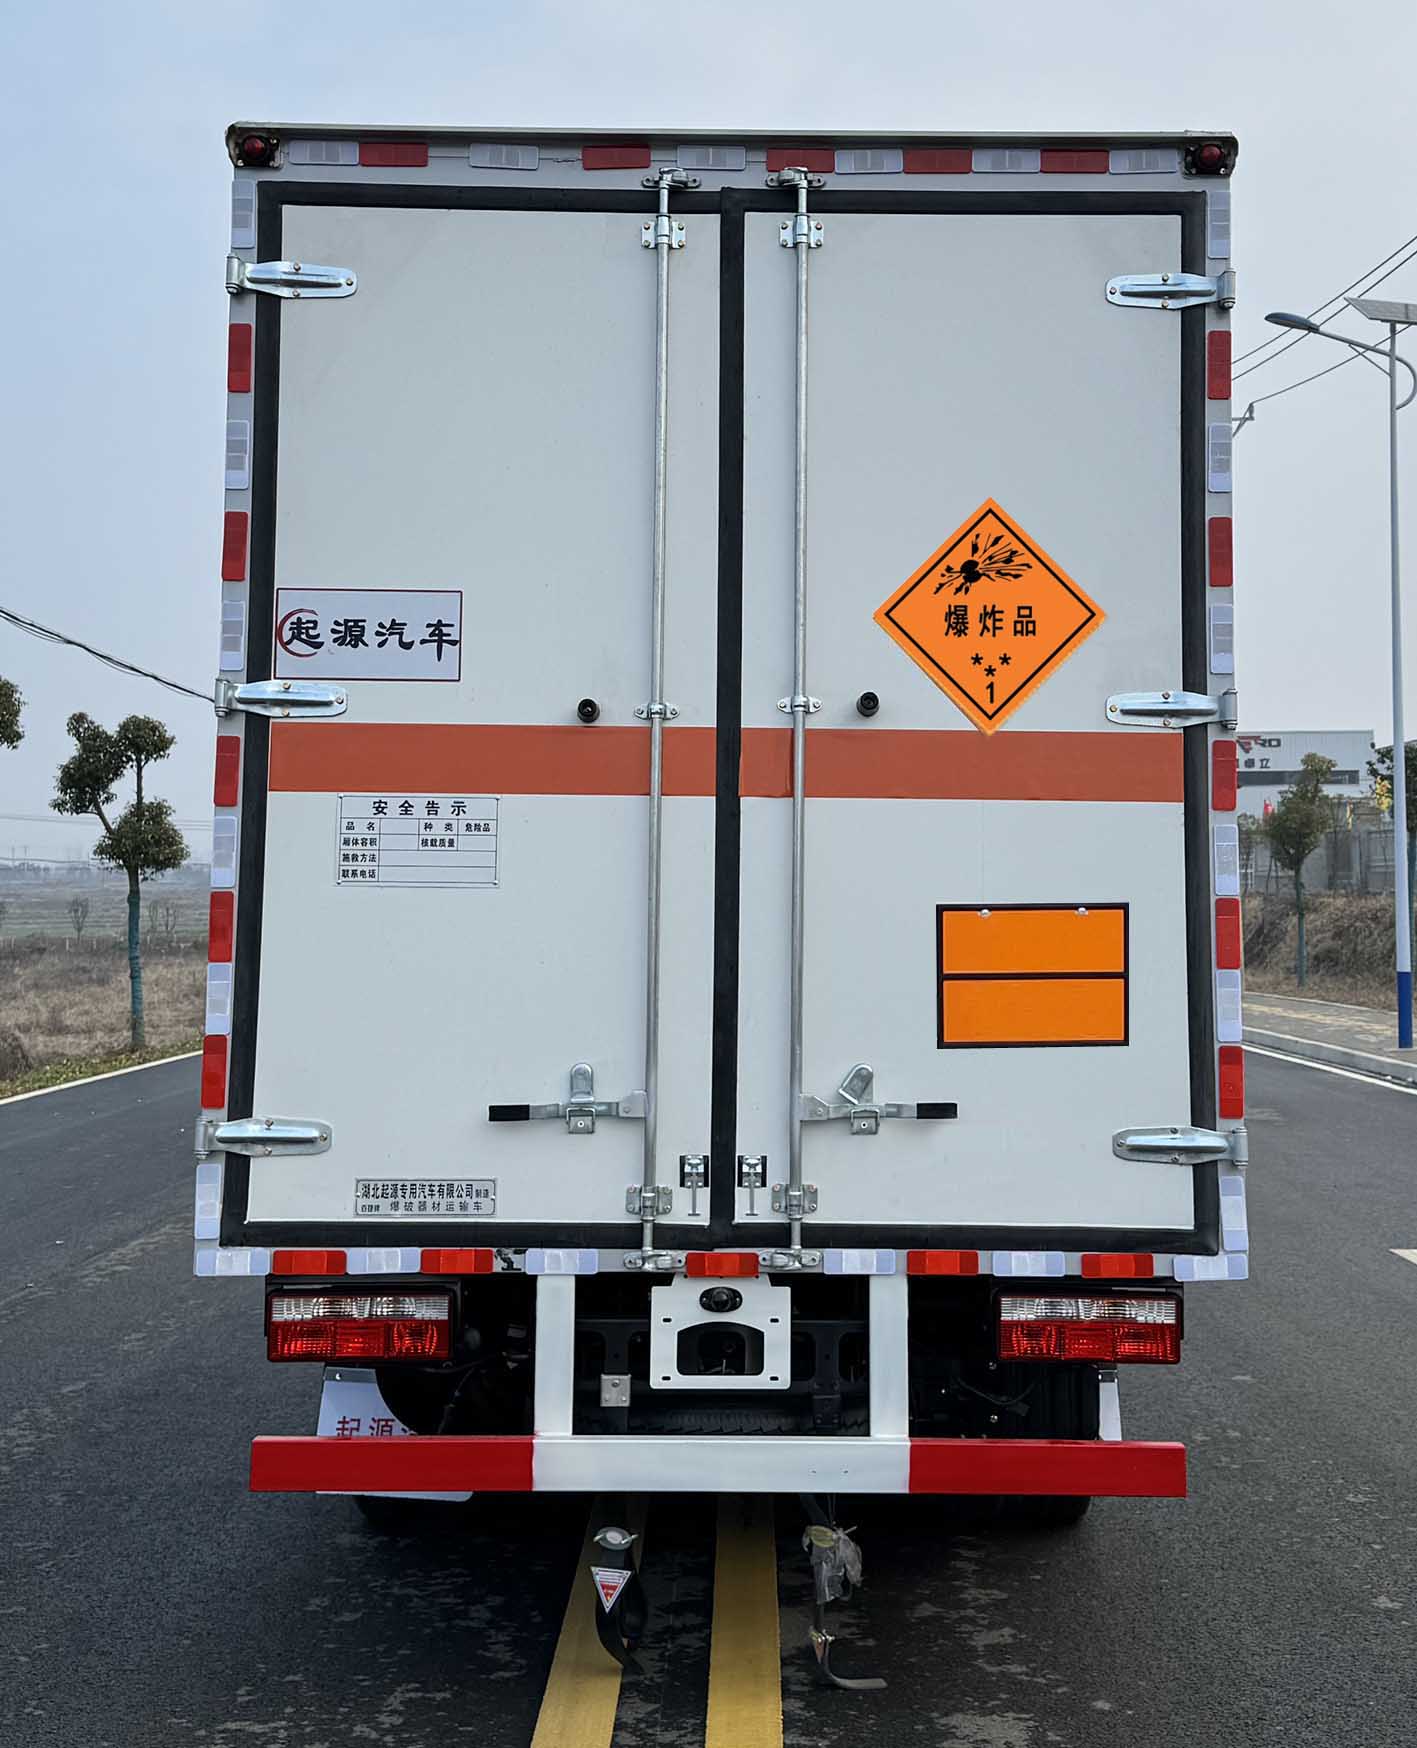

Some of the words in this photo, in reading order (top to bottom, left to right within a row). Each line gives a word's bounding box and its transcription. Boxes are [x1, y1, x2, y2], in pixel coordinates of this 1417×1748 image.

[944, 604, 1036, 638] 爆炸品
[287, 617, 460, 662] 起源汽车
[985, 681, 995, 704] 1
[372, 800, 467, 816] 安全告示
[345, 821, 375, 831] 品名
[465, 822, 491, 832] 危险品
[341, 869, 377, 879] 联系电话
[336, 1416, 418, 1436] 起源
